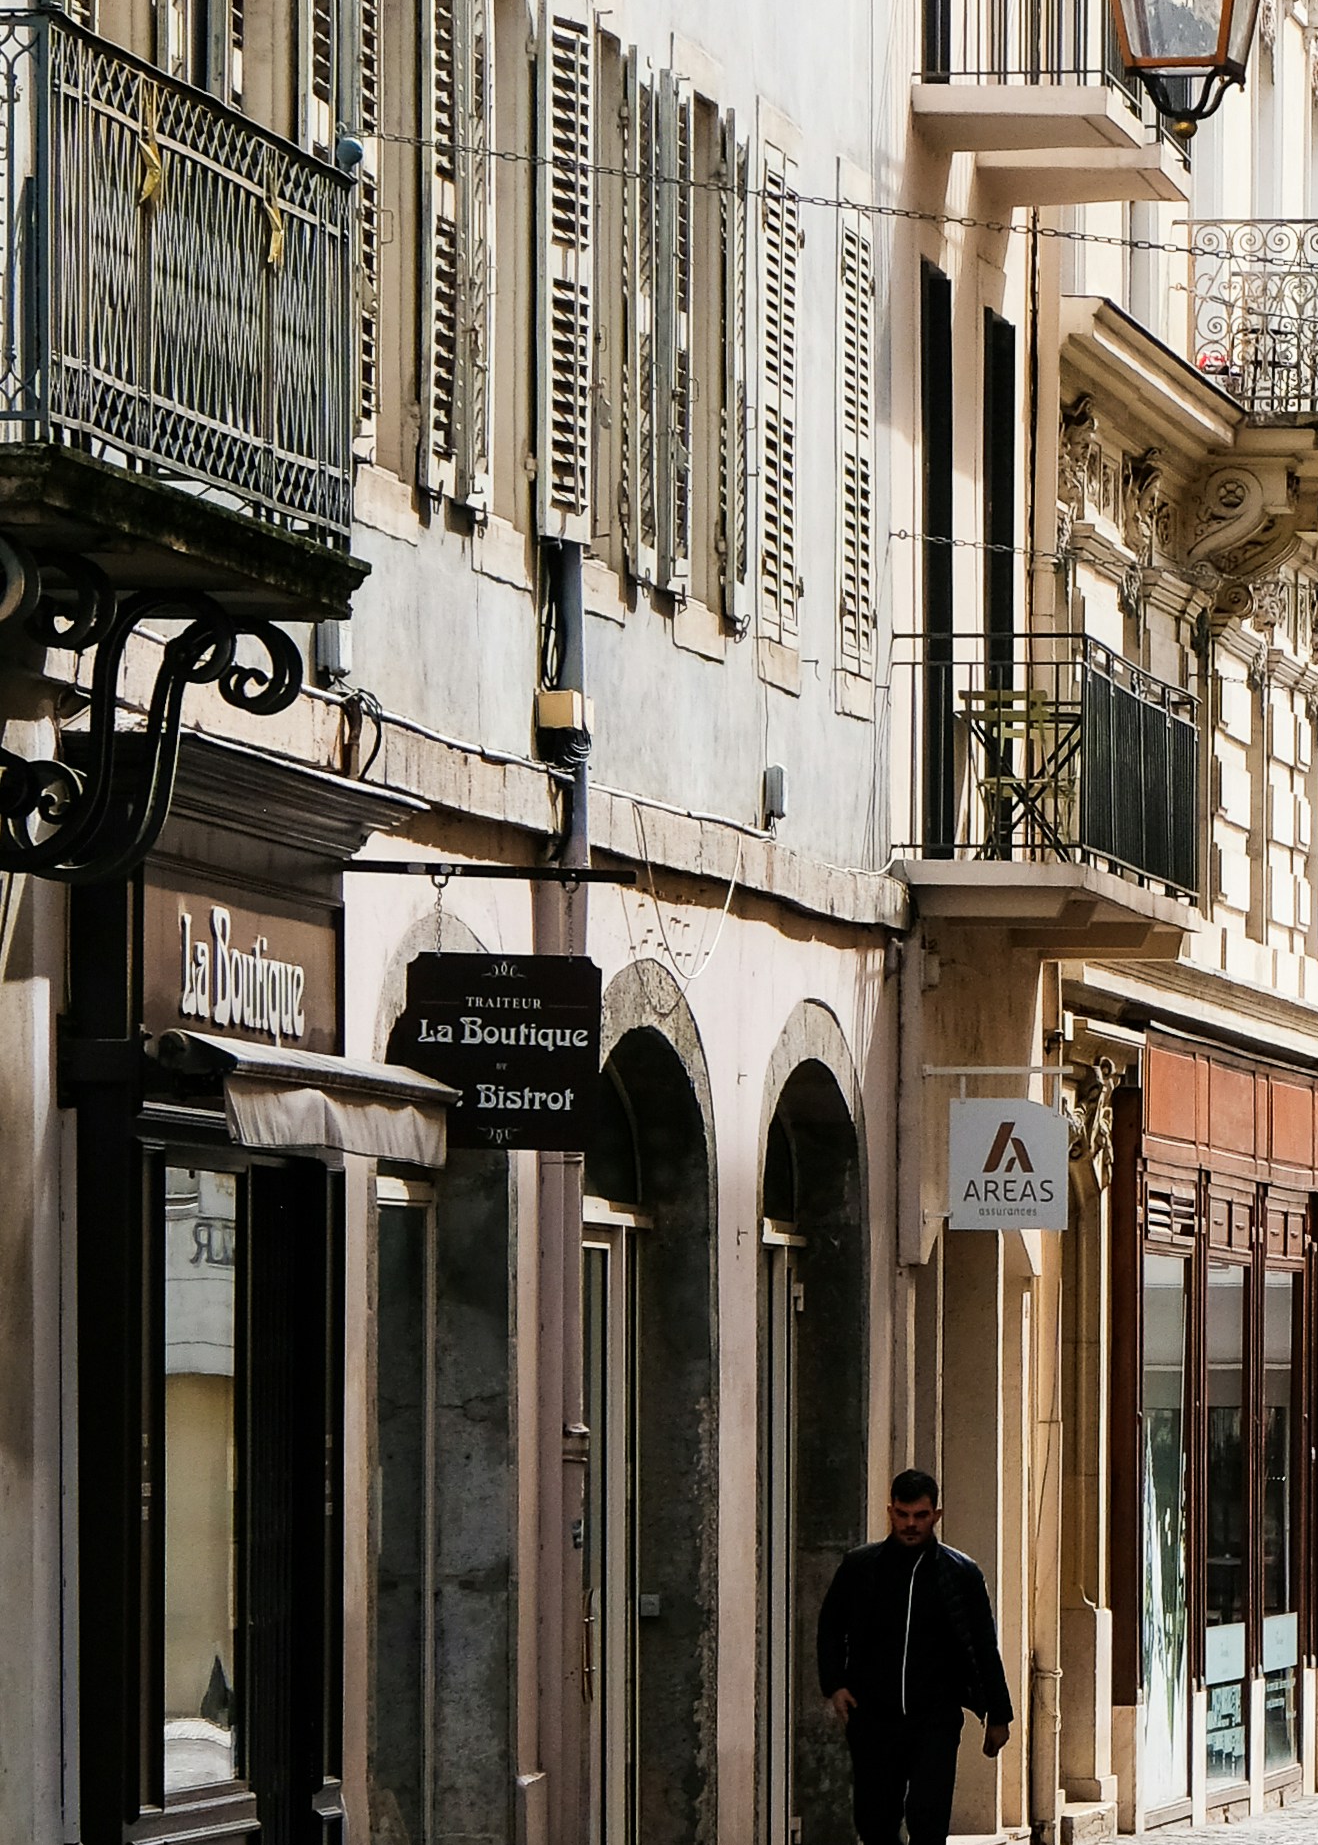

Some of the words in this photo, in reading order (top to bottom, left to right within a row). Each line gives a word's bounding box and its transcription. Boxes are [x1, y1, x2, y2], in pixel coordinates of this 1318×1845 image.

[179, 912, 211, 1018] La
[212, 905, 305, 1047] Boutique
[418, 1018, 453, 1043] La
[459, 1016, 589, 1051] Boutique
[475, 1084, 575, 1111] Bistrot
[963, 1179, 1054, 1202] AREAS
[978, 1206, 1038, 1217] assurances
